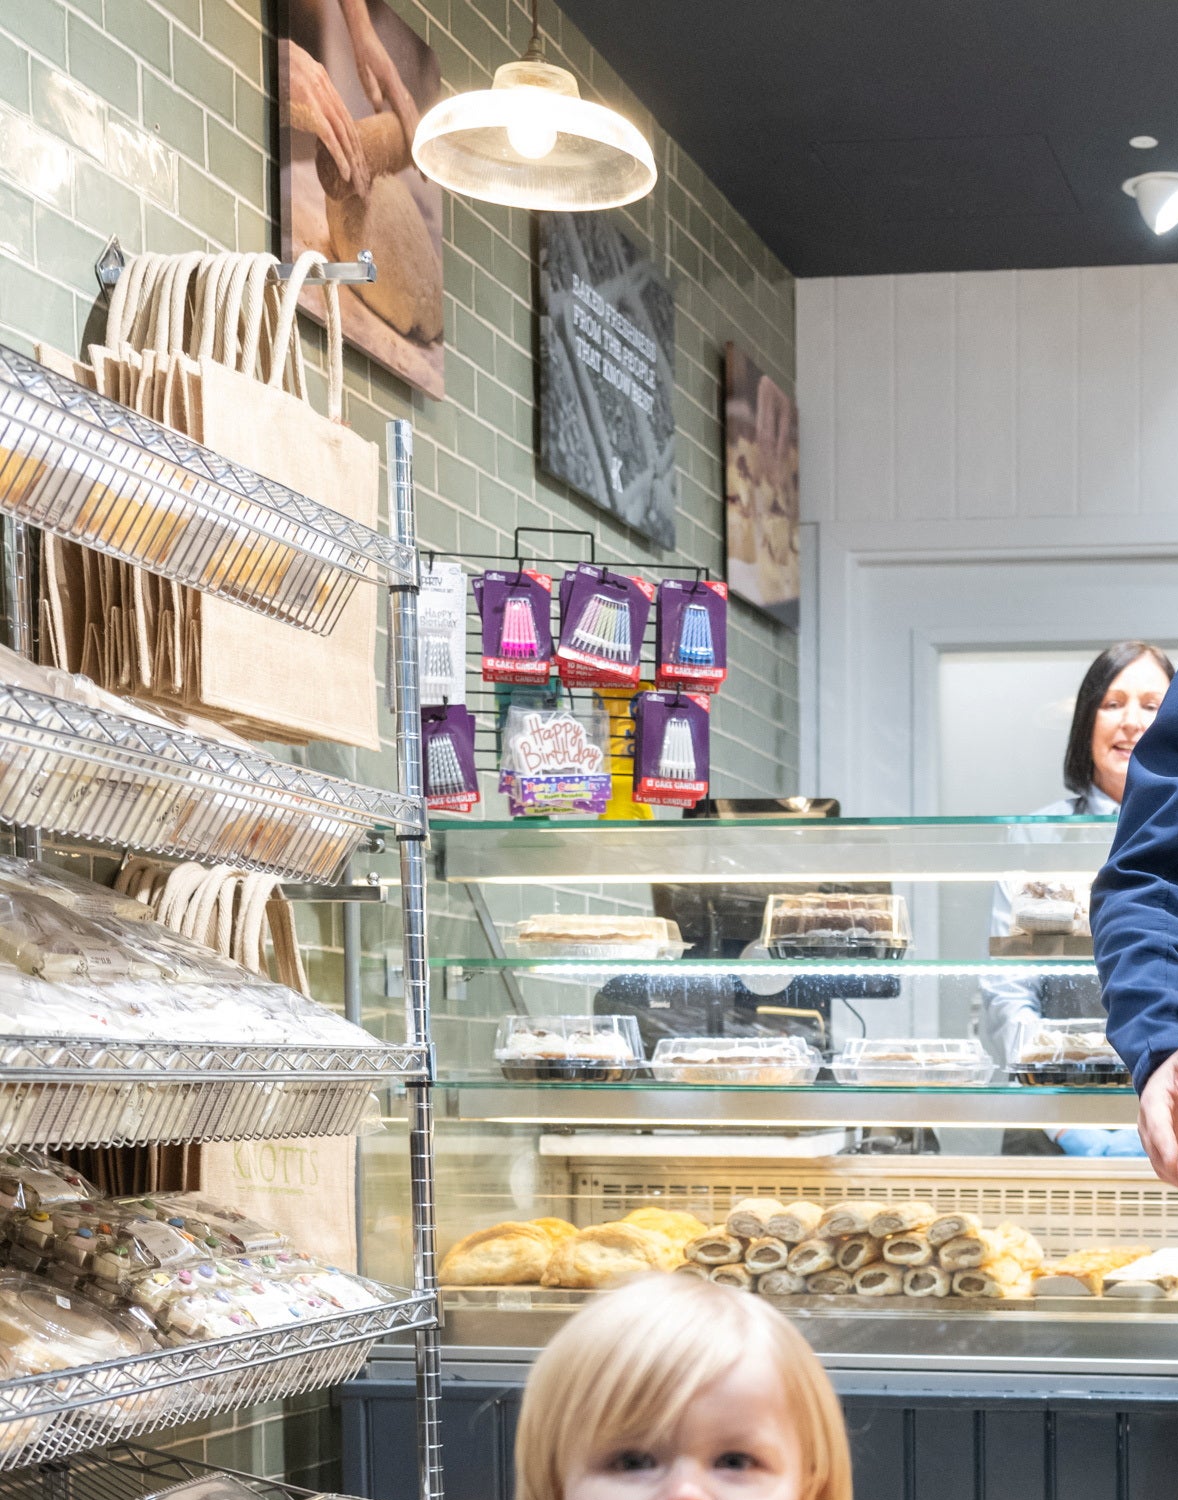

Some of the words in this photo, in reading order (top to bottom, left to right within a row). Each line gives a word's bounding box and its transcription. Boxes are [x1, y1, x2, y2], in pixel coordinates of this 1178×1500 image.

[572, 273, 605, 317] BAKED
[573, 304, 602, 345] FROM
[602, 329, 622, 361] THE
[622, 346, 657, 391] PEOPLE
[575, 336, 601, 373] THAT
[602, 358, 631, 397] KNOW
[631, 380, 655, 415] BEST
[494, 660, 514, 669] CAKE
[514, 662, 546, 671] CANDLES
[529, 717, 583, 751] Happy
[520, 739, 601, 772] Birthday
[445, 792, 477, 804] CANDLES
[655, 781, 673, 789] CAKE
[233, 1142, 318, 1186] KNOTTS
